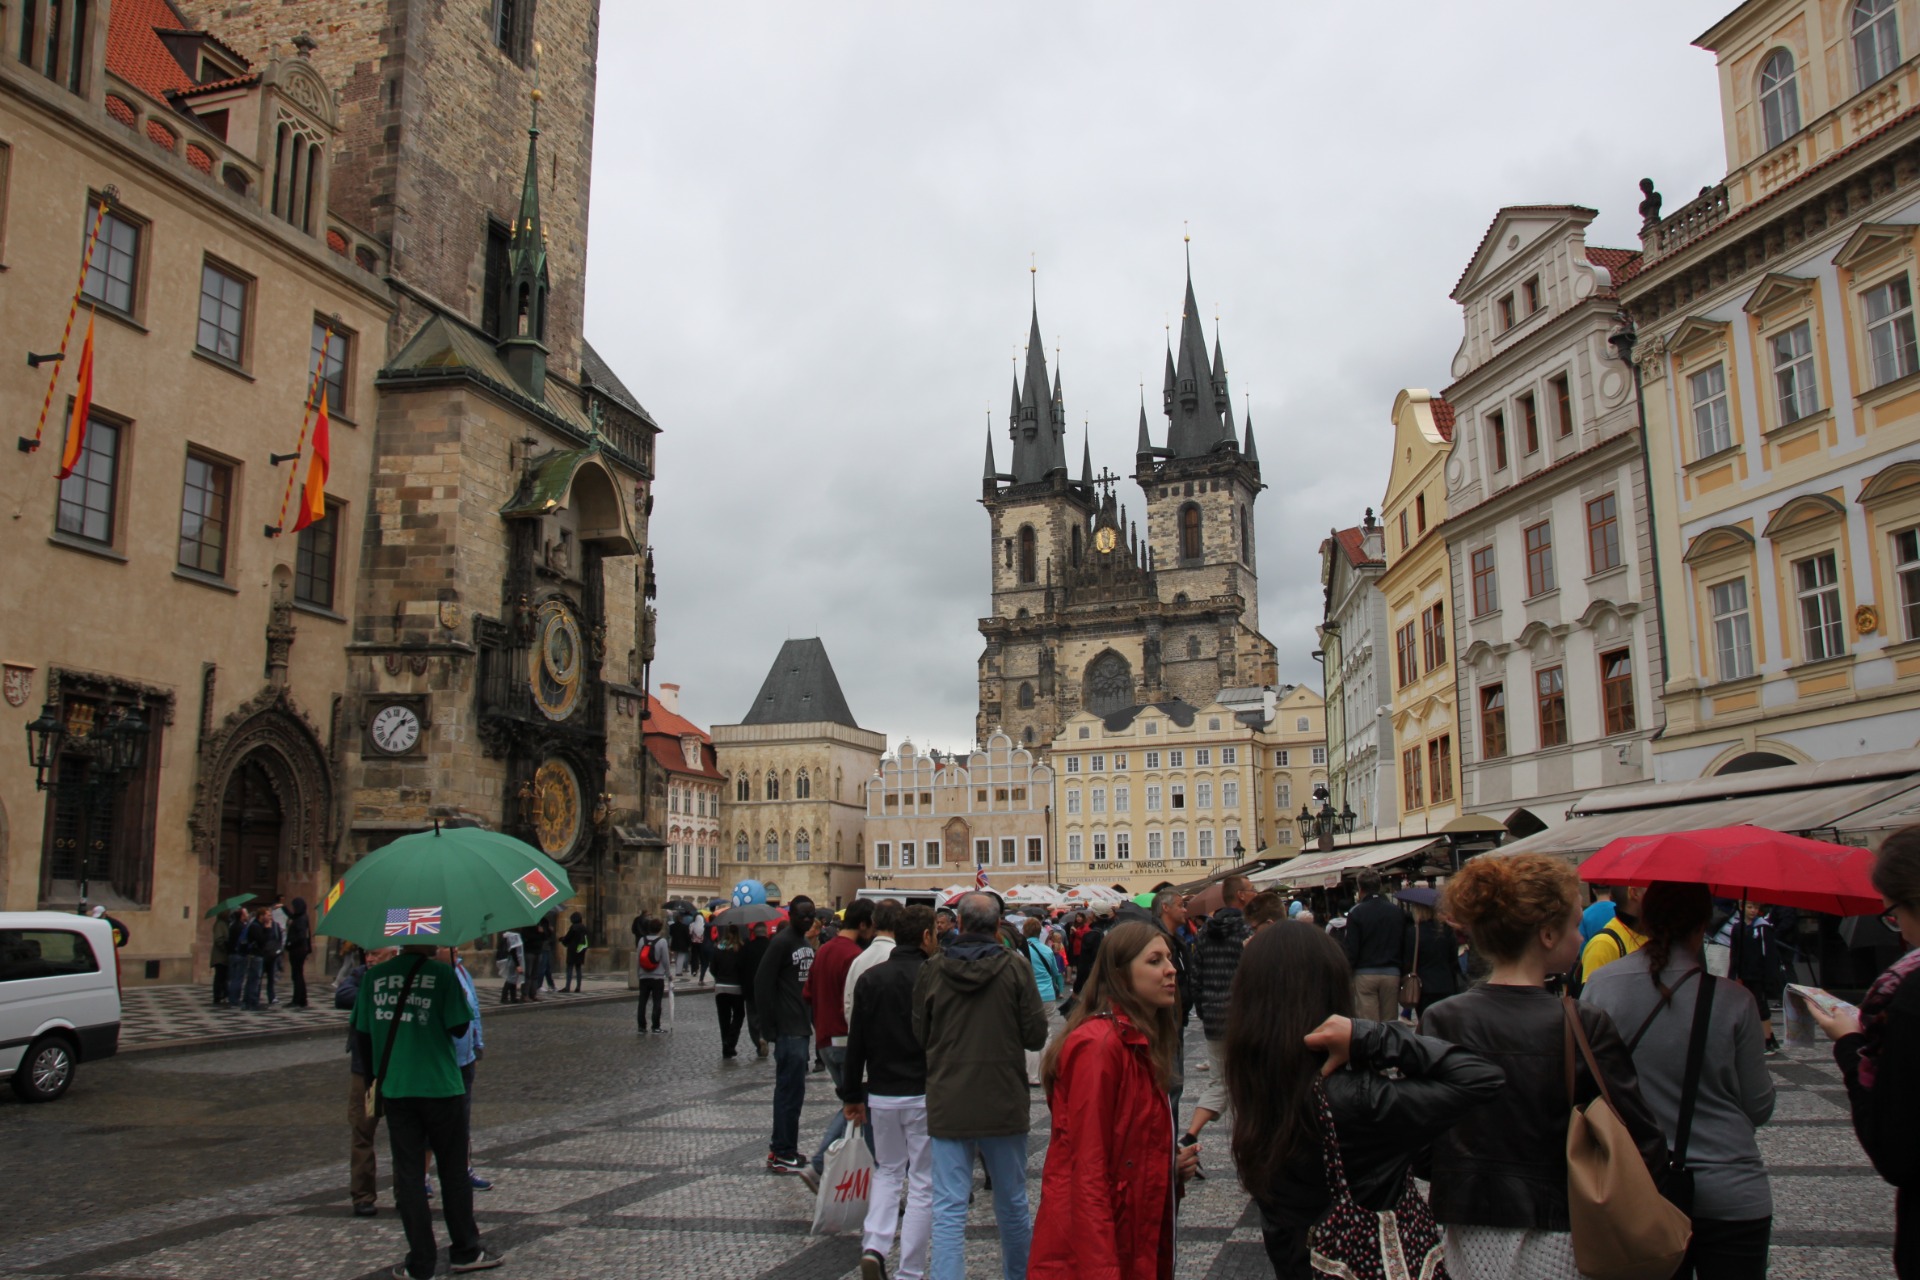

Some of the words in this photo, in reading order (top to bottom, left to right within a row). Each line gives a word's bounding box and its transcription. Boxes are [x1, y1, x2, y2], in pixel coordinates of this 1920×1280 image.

[1097, 862, 1124, 870] MUCHA
[1136, 860, 1167, 869] WARHOL
[374, 975, 436, 993] FREE
[375, 1008, 414, 1022] tour
